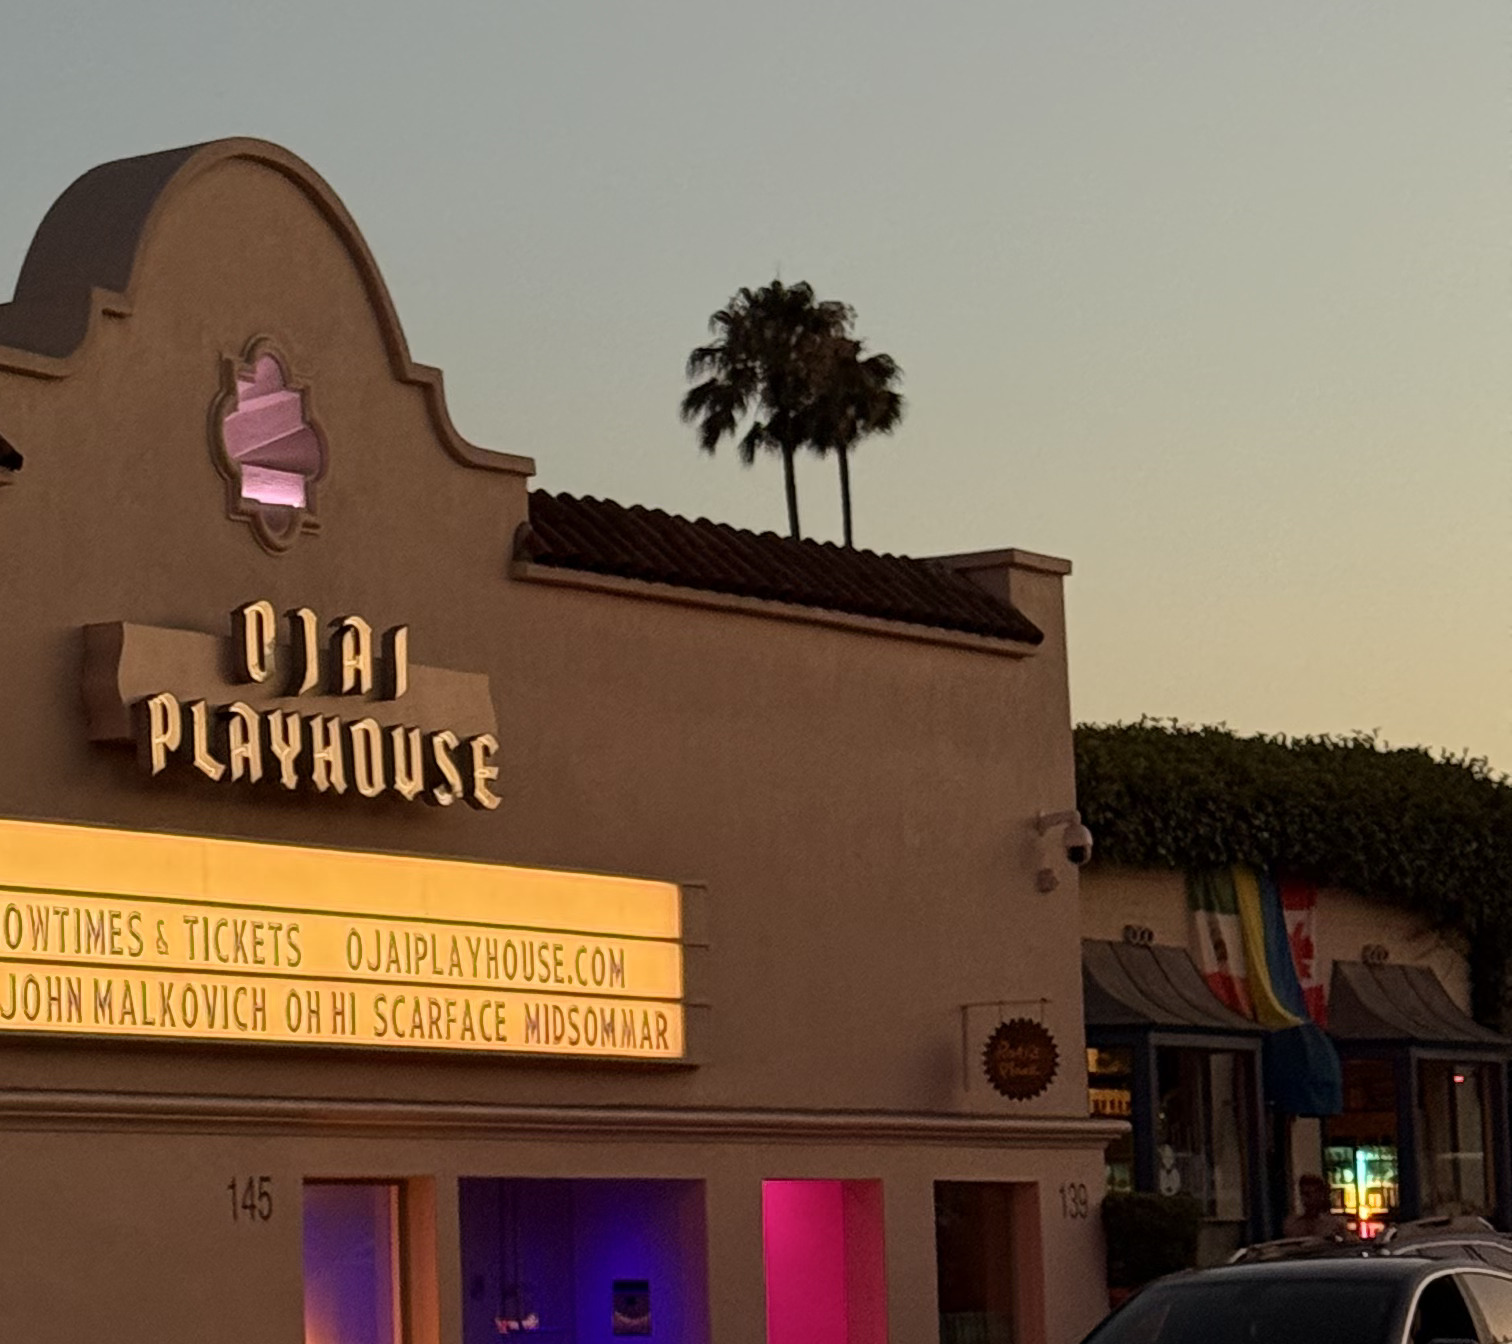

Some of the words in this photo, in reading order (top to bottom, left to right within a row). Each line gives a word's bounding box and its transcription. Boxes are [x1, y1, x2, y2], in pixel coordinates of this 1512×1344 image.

[237, 599, 409, 700] OJAI
[147, 691, 503, 810] PLAYHOUSE
[156, 919, 169, 955] &
[183, 915, 302, 968] TICKETS
[346, 927, 626, 988] OJAIPLAYHOUSE.COM
[0, 973, 82, 1024] JOHN
[93, 977, 267, 1032] MALKOVICH
[286, 989, 321, 1034] OH
[332, 991, 356, 1036] HI
[373, 993, 507, 1043] SCARFACE
[524, 1002, 670, 1051] MIDSOMMAR
[227, 1176, 273, 1221] 145
[1058, 1182, 1089, 1219] 139
